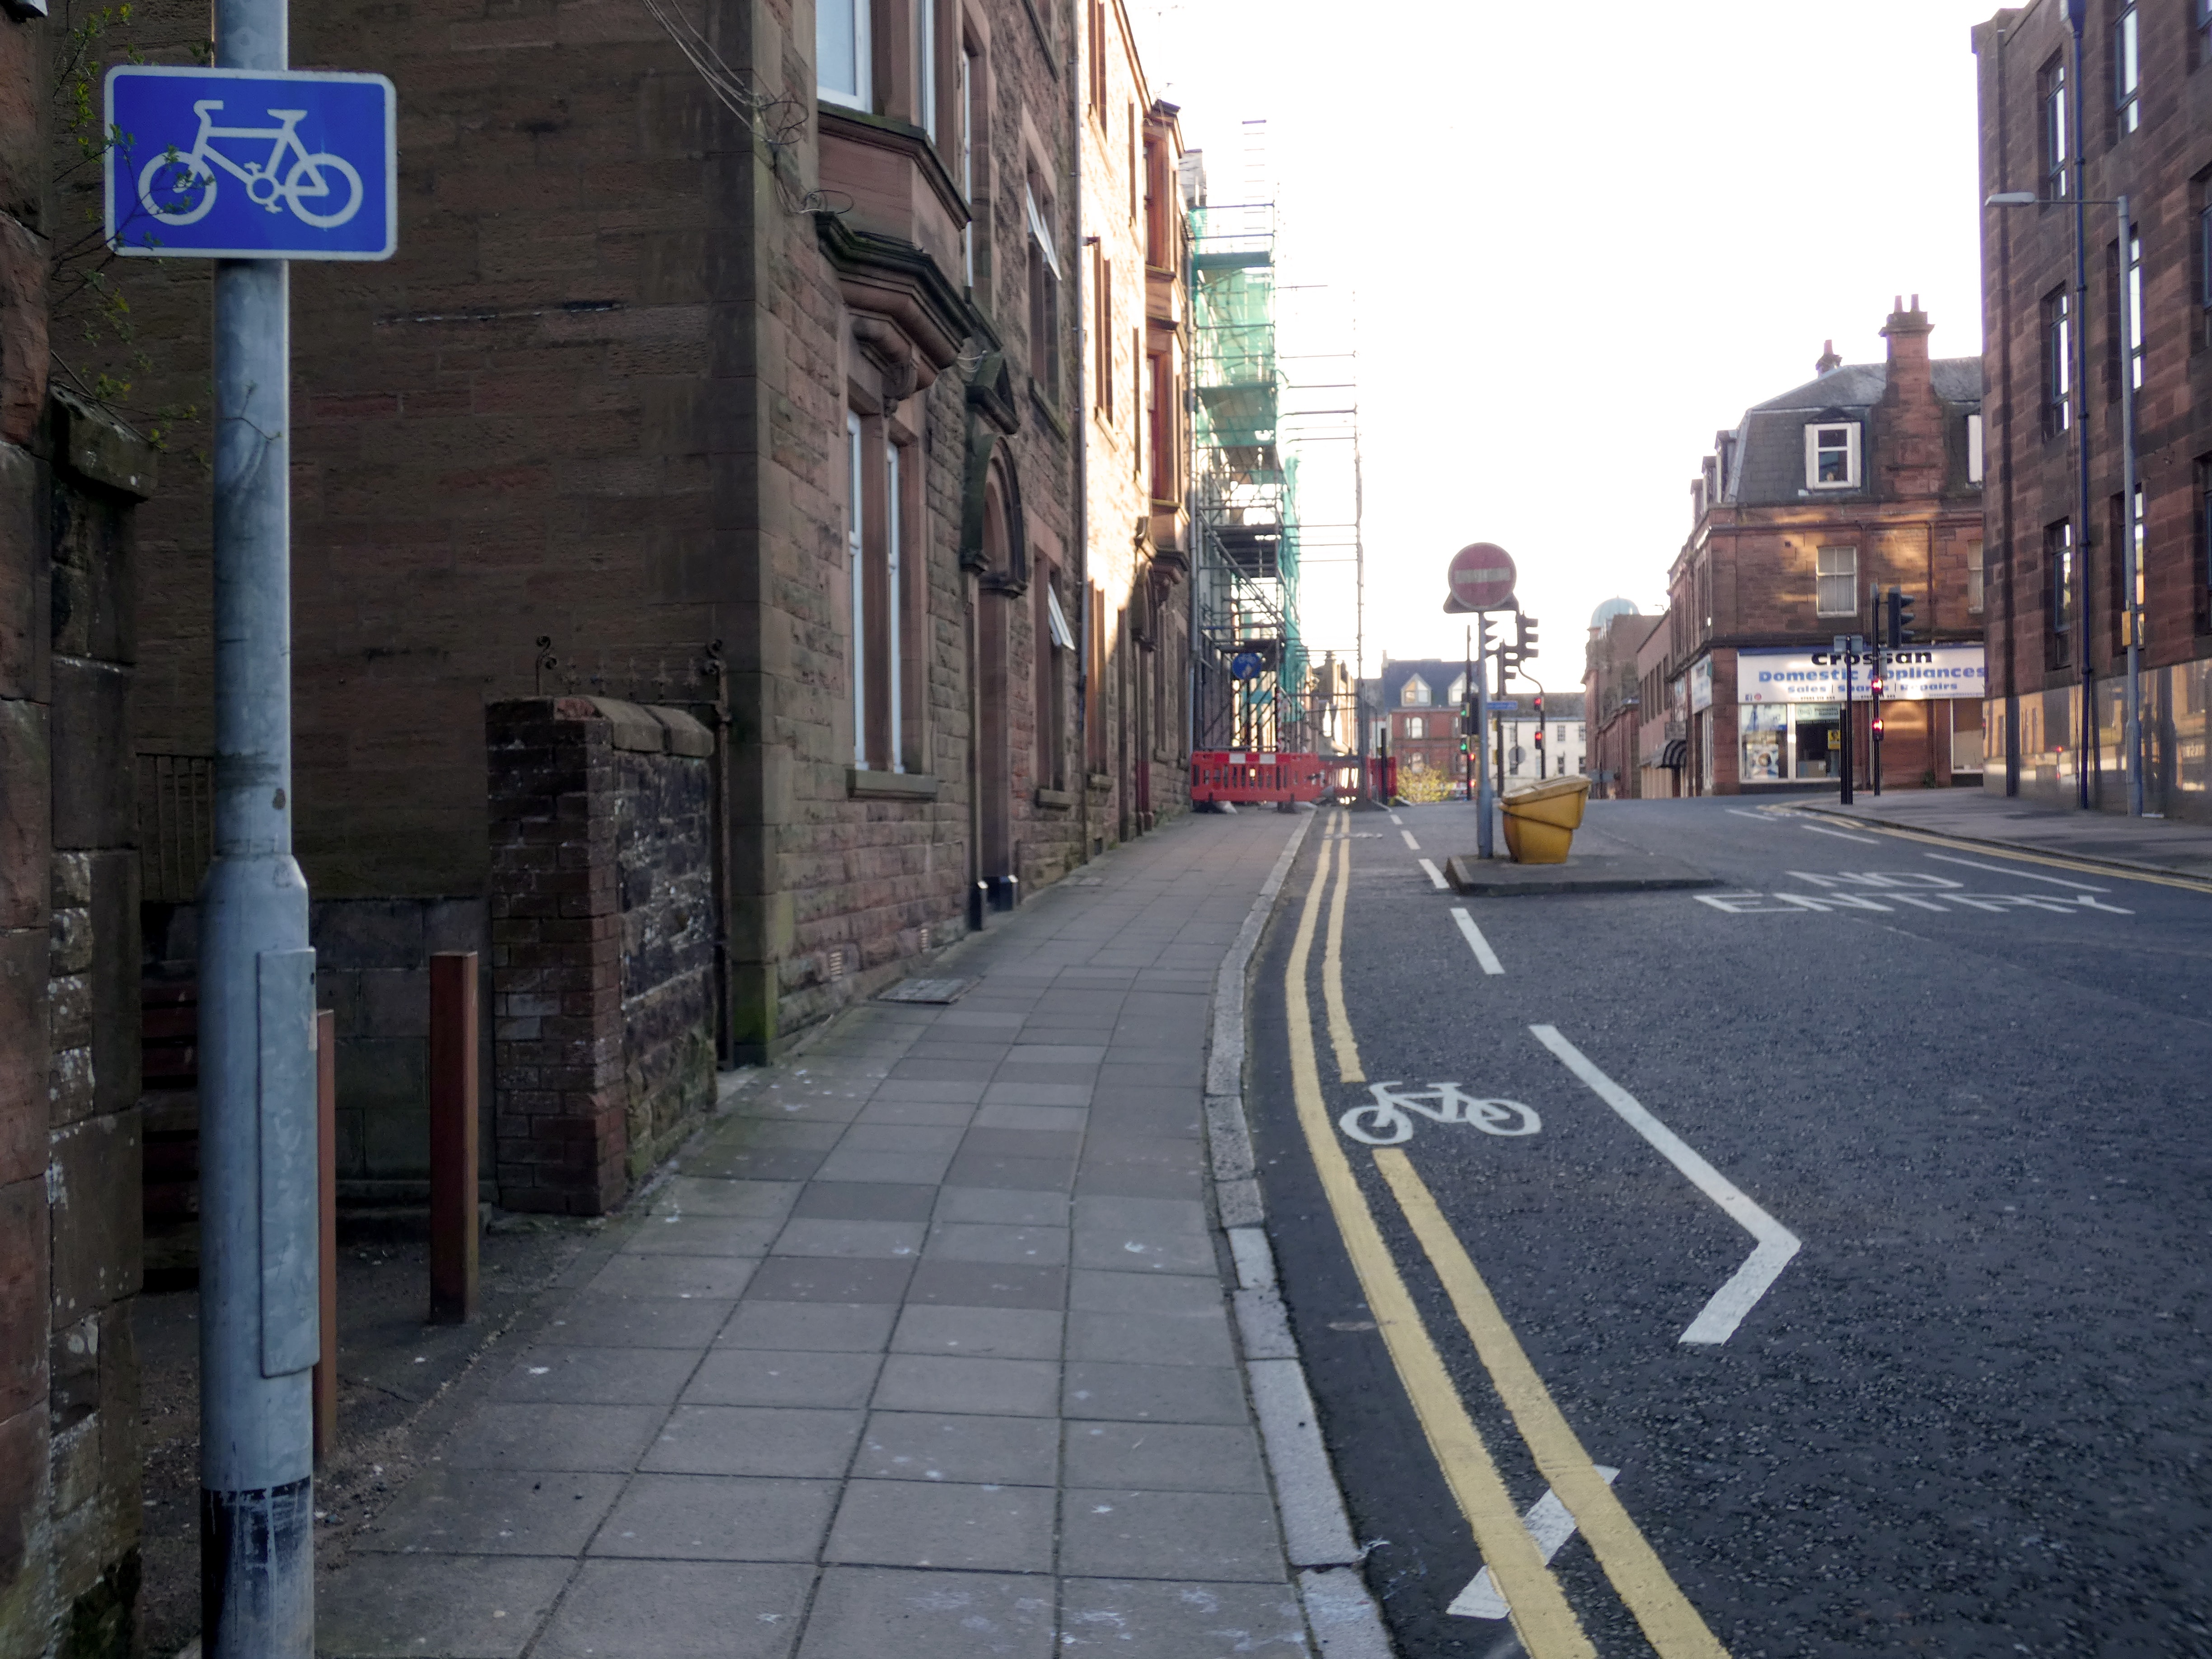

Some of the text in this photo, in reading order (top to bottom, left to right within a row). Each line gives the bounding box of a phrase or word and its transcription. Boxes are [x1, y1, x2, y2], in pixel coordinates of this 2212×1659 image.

[1759, 670, 1859, 682] Domestic
[1838, 684, 1889, 692] Sars
[1900, 683, 1958, 692] Rpairs
[1786, 870, 1964, 888] NO
[1693, 892, 2136, 914] ENTRY
